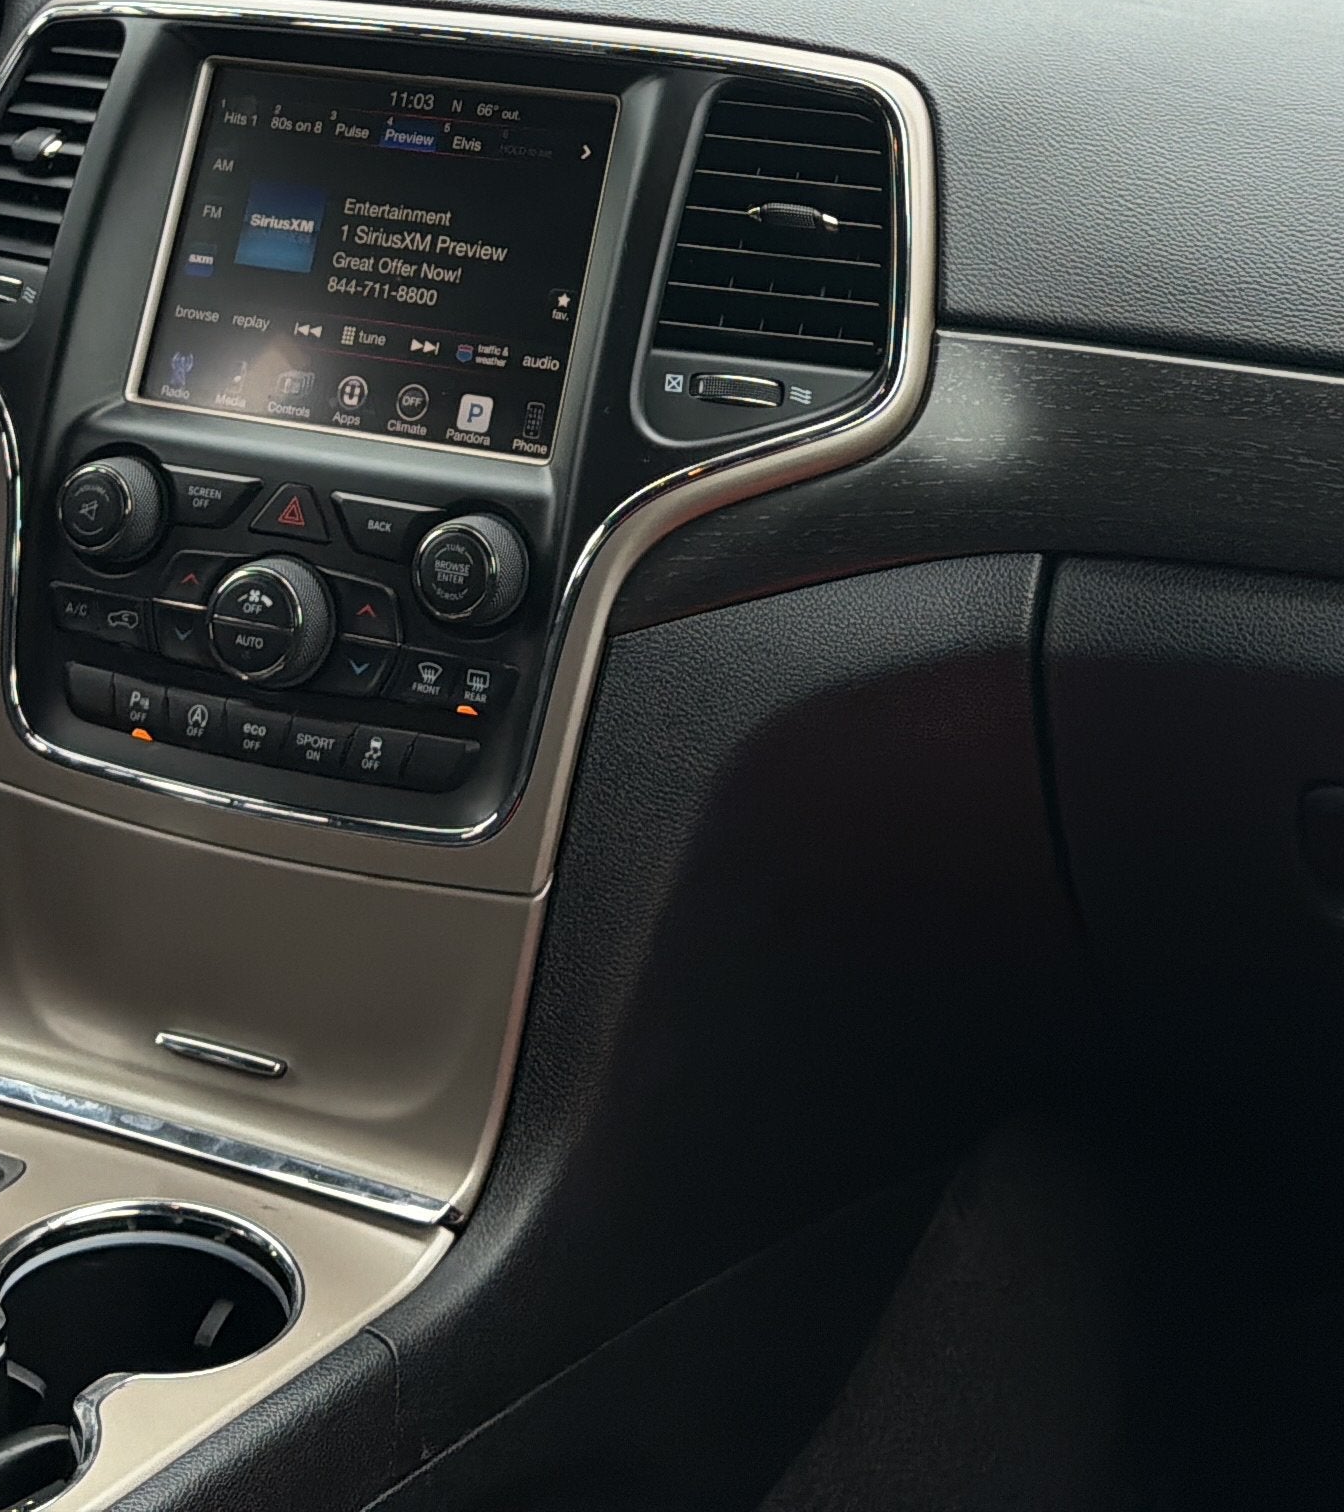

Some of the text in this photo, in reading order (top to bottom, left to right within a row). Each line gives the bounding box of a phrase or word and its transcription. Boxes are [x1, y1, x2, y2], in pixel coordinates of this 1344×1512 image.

[274, 104, 282, 115] 2
[390, 90, 521, 121] 11:03 N 66° out.
[224, 111, 248, 126] Hits
[329, 110, 337, 121] 3
[387, 116, 394, 126] 4
[270, 116, 323, 134] 80s on 8
[334, 123, 370, 139] Pulse
[385, 128, 435, 147] Preview
[452, 135, 482, 152] Elvis
[213, 158, 234, 172] AM
[202, 204, 223, 219] FM
[344, 198, 452, 227] Entertainment
[250, 213, 315, 233] SiriusXM
[340, 224, 509, 262] 1 SiriusXM Preview
[189, 253, 214, 265] sxm
[332, 251, 463, 284] Great Offer Now!
[327, 276, 438, 306] 844-711-8800
[175, 304, 220, 324] browse
[551, 309, 570, 322] fav.
[232, 314, 271, 333] replay
[358, 329, 387, 346] tune
[477, 344, 501, 356] traffic
[475, 355, 508, 368] weather
[522, 355, 560, 371] audio
[161, 384, 191, 400] Radio
[215, 394, 247, 409] Media
[402, 394, 422, 408] OFF
[267, 401, 312, 418] Controls
[332, 411, 362, 426] Apps
[387, 419, 428, 436] Climate
[446, 428, 492, 447] Pandora
[512, 438, 549, 455] Phone
[188, 486, 222, 499] SCREEN
[192, 498, 210, 508] OFF
[367, 519, 392, 532] BACK
[446, 543, 466, 554] TUNE
[434, 559, 471, 574] BROWSE
[437, 574, 465, 585] ENTER
[65, 601, 87, 616] A/C
[243, 603, 263, 615] OFF
[235, 634, 264, 650] AUTO
[412, 681, 441, 695] FRONT
[464, 691, 488, 704] REAR
[130, 710, 147, 722] OFF
[186, 726, 204, 737] OFF
[242, 722, 267, 737] eco
[243, 739, 261, 750] OFF
[296, 733, 336, 751] SPORT
[306, 749, 321, 762] ON
[361, 758, 380, 771] OFF
